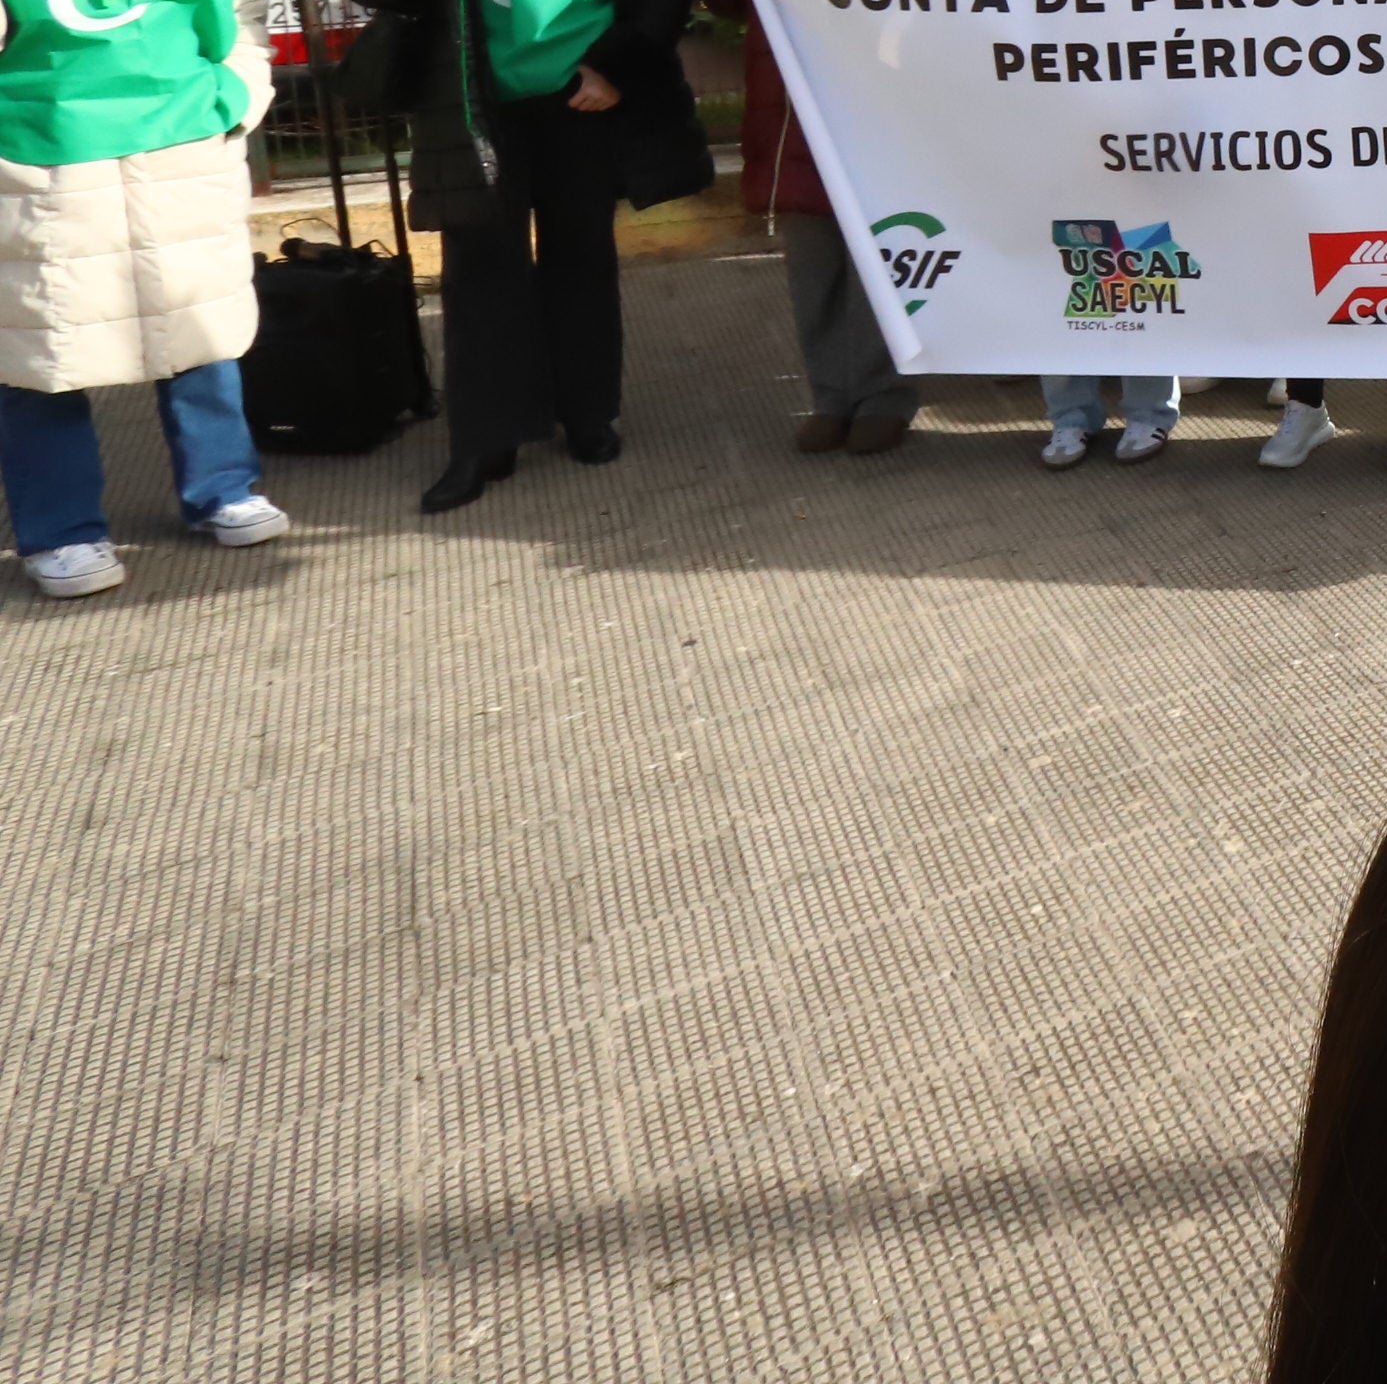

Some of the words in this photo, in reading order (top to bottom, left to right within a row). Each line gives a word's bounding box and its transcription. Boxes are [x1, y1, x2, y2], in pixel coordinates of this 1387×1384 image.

[993, 27, 1386, 83] PERIFÉRICOS
[1099, 126, 1333, 173] SERVICIOS
[879, 248, 962, 291] SIF
[1058, 247, 1203, 281] USCAL
[1070, 280, 1186, 315] SAECYL
[1066, 320, 1147, 333] TISCYL-CESM
